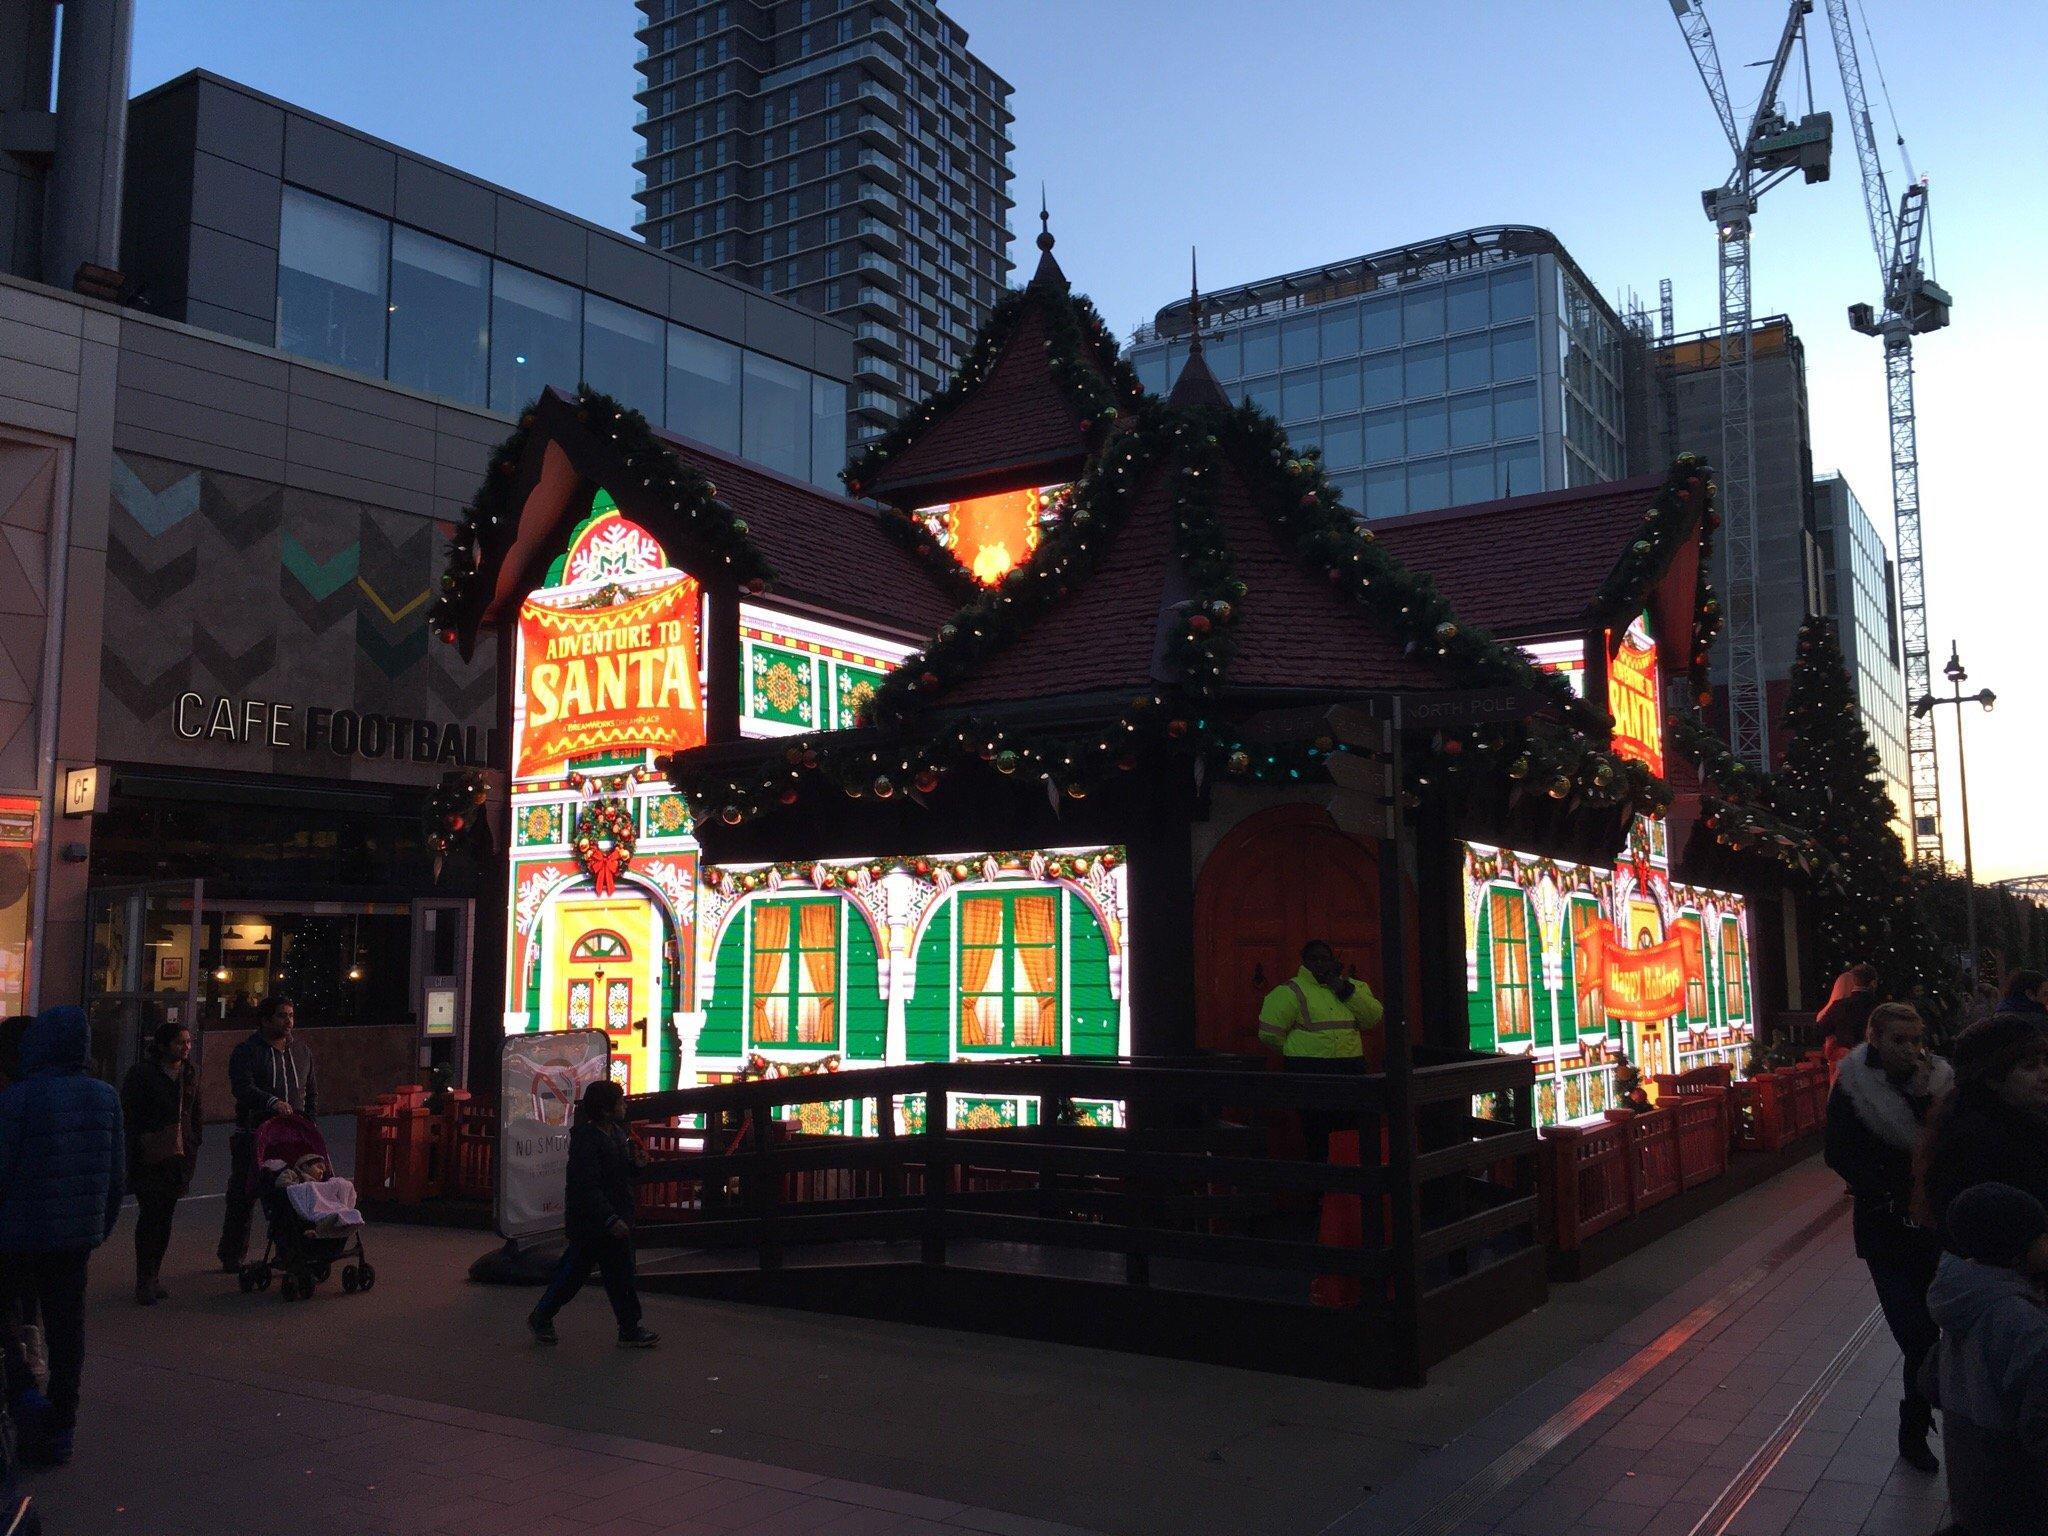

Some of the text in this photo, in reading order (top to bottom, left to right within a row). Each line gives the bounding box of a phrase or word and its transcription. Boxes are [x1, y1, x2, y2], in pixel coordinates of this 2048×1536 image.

[546, 620, 682, 660] ADVENTURE TO
[529, 645, 696, 728] SANTA
[173, 692, 293, 747] CAFE
[1407, 697, 1516, 718] NORTH POLE
[74, 778, 89, 805] CF
[516, 1135, 570, 1157] NO SMOK
